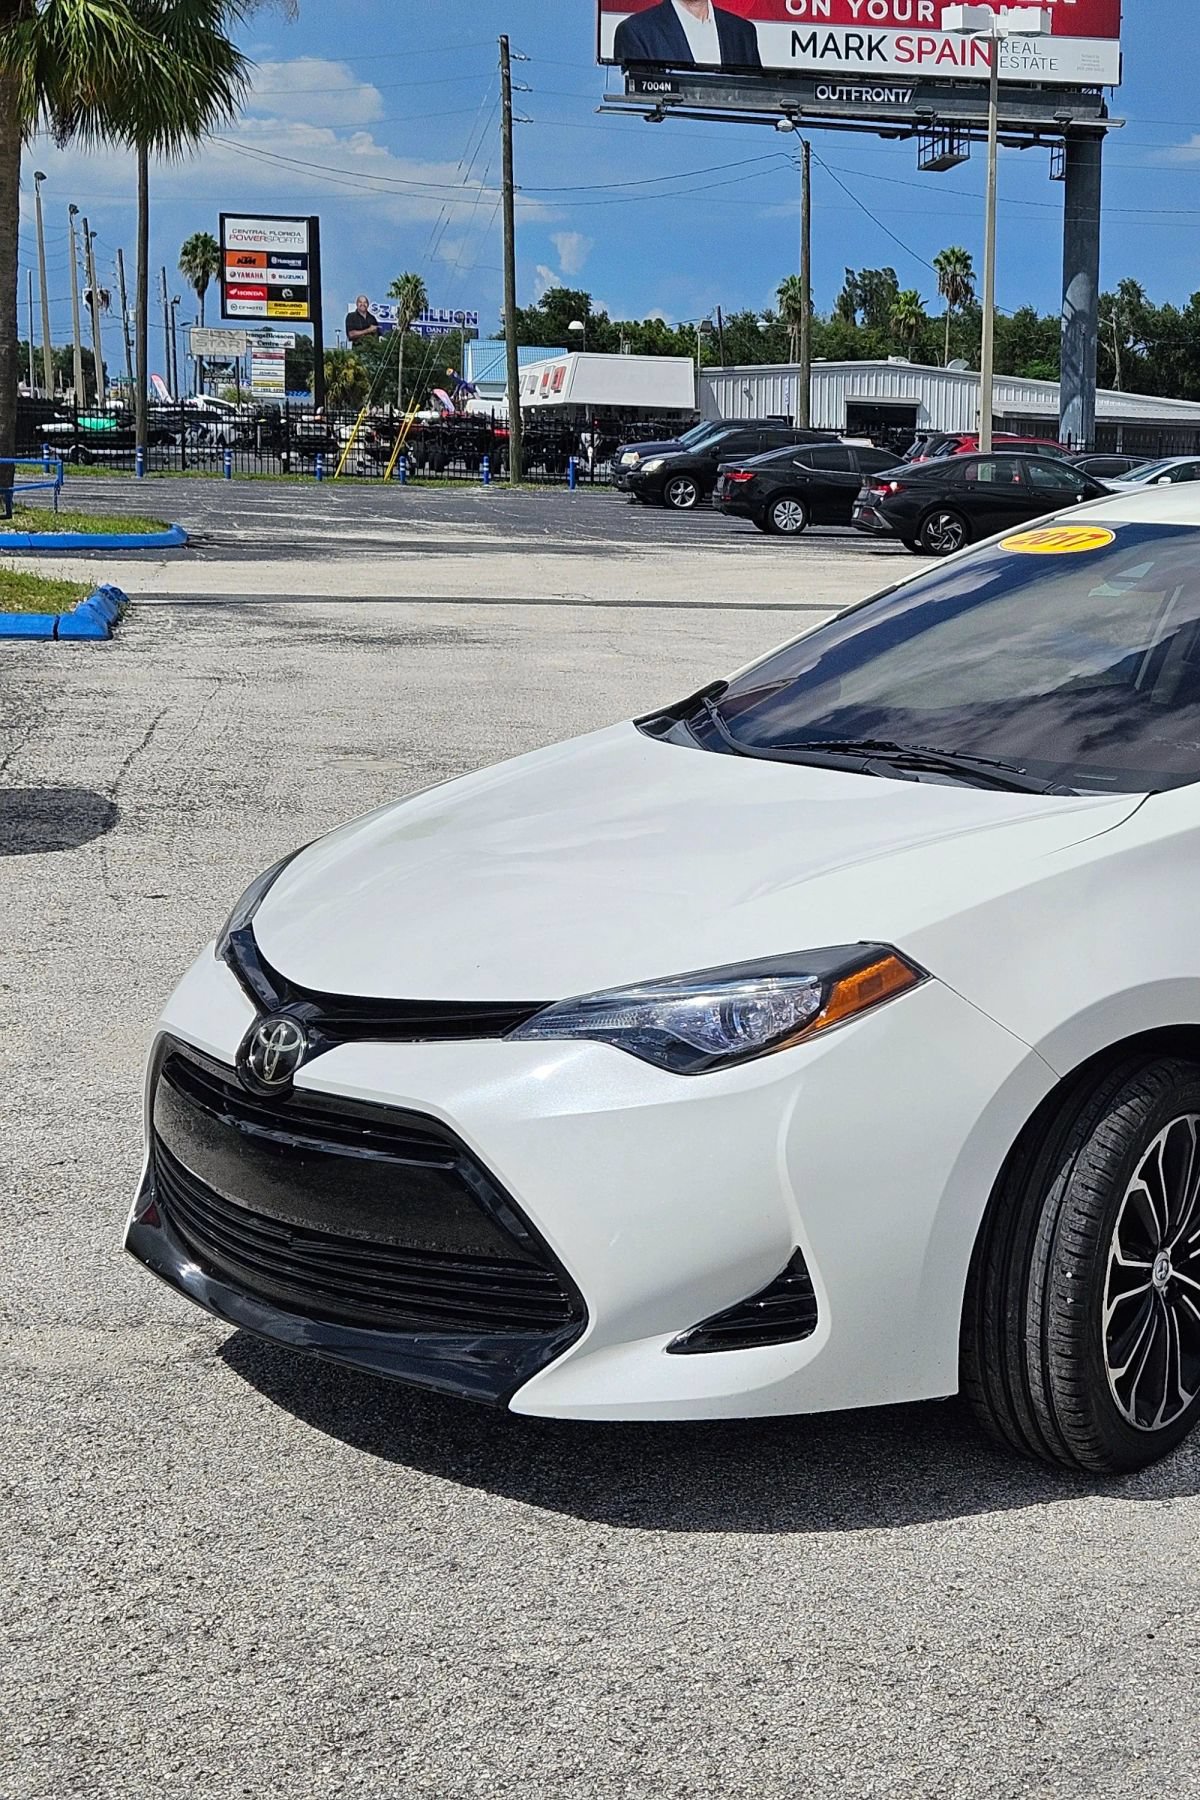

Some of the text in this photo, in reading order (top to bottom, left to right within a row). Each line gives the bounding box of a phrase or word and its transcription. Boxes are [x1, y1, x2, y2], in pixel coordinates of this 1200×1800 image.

[785, 0, 831, 17] ON
[850, 0, 935, 22] YOUR
[790, 30, 992, 67] MARK SPAIN
[1000, 41, 1042, 55] REAL
[1000, 56, 1059, 71] ESTATE
[641, 80, 671, 92] 7004N
[229, 233, 305, 244] POWERSPORTS
[236, 256, 257, 265] KTM
[236, 271, 264, 279] YAMAHA
[1005, 531, 1109, 548] 2017
